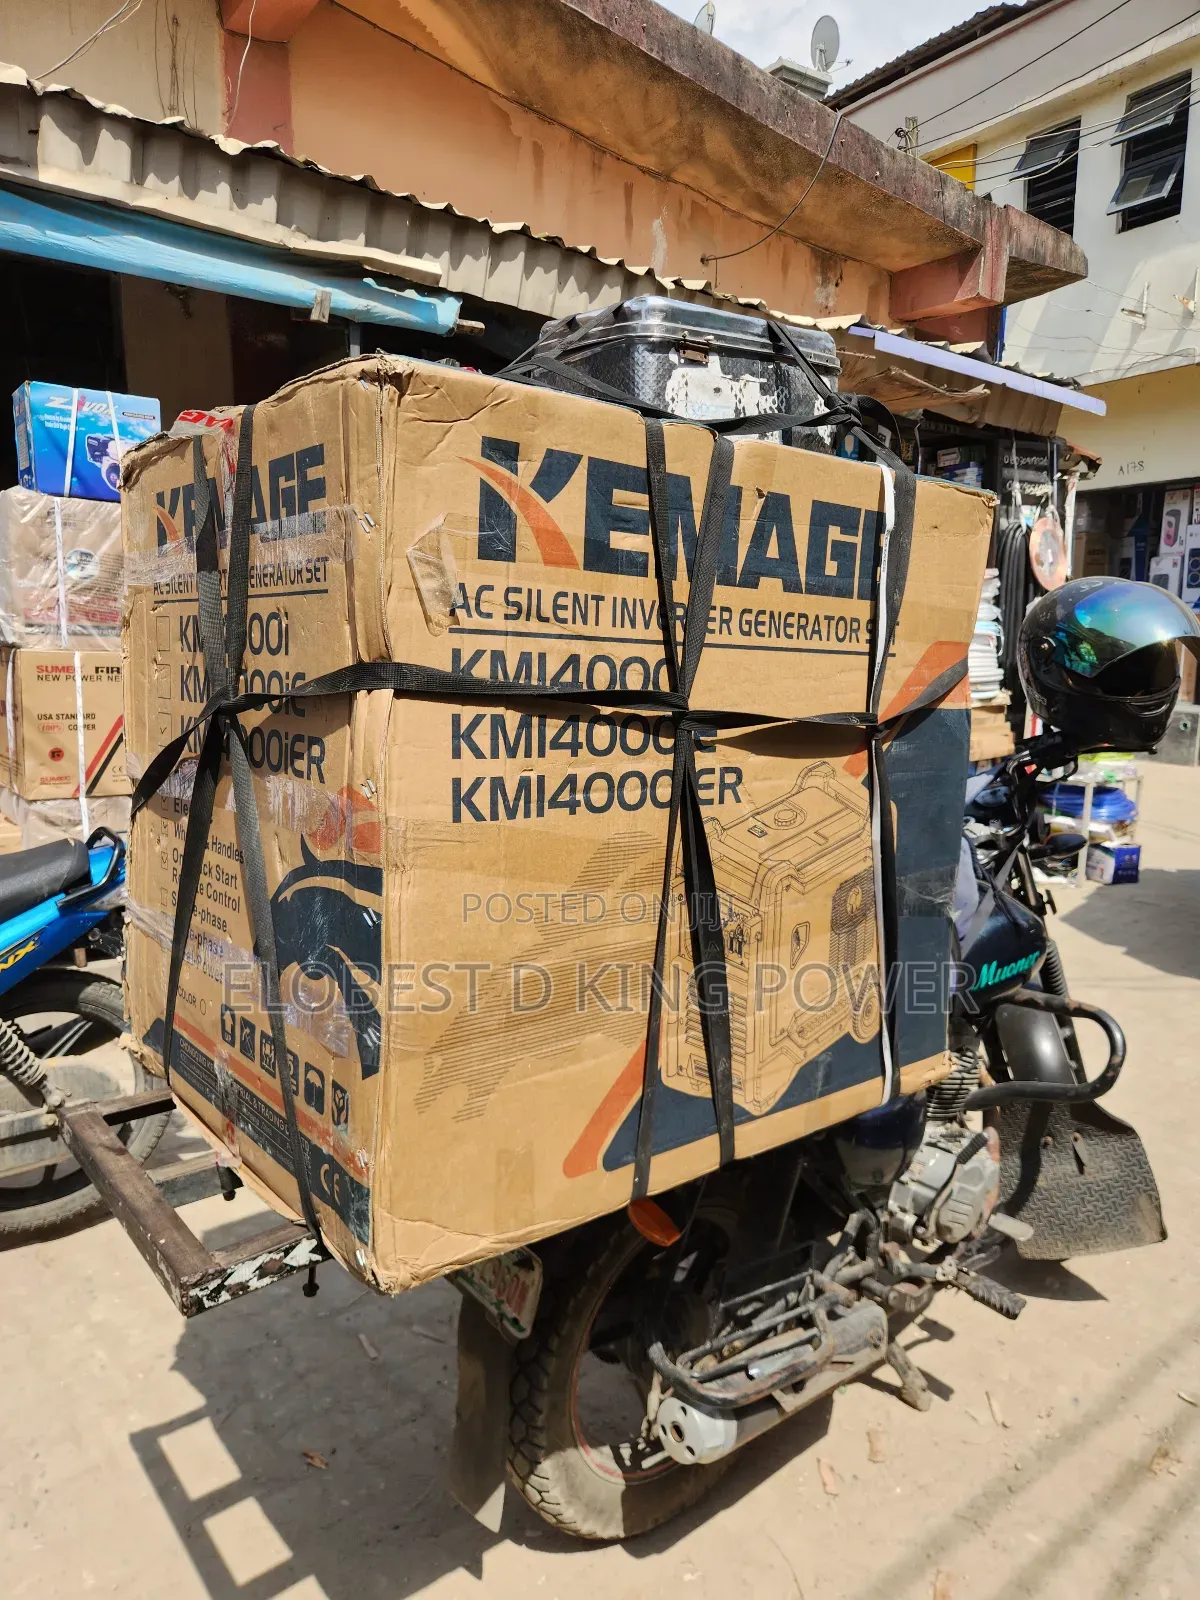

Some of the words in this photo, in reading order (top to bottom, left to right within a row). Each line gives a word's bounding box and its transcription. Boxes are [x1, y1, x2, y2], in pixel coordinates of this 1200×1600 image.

[457, 435, 887, 601] KEMAG
[249, 563, 302, 588] ENERATOR
[448, 582, 495, 620] AC
[503, 586, 605, 627] SILENT
[611, 596, 733, 636] INVRER
[738, 607, 861, 645] GENERATOR
[36, 665, 79, 674] SUME
[95, 666, 122, 675] FIR
[37, 674, 61, 682] NEW
[65, 675, 105, 683] PWER
[107, 675, 122, 683] NE
[451, 647, 668, 692] KMI400
[37, 713, 53, 721] USA
[55, 713, 96, 721] STANARD
[450, 712, 718, 761] KMI4000E
[451, 766, 743, 825] KMI4000ER
[211, 835, 245, 865] Handles
[215, 864, 238, 890] Start
[206, 882, 241, 914] Control
[320, 1163, 341, 1206] CE
